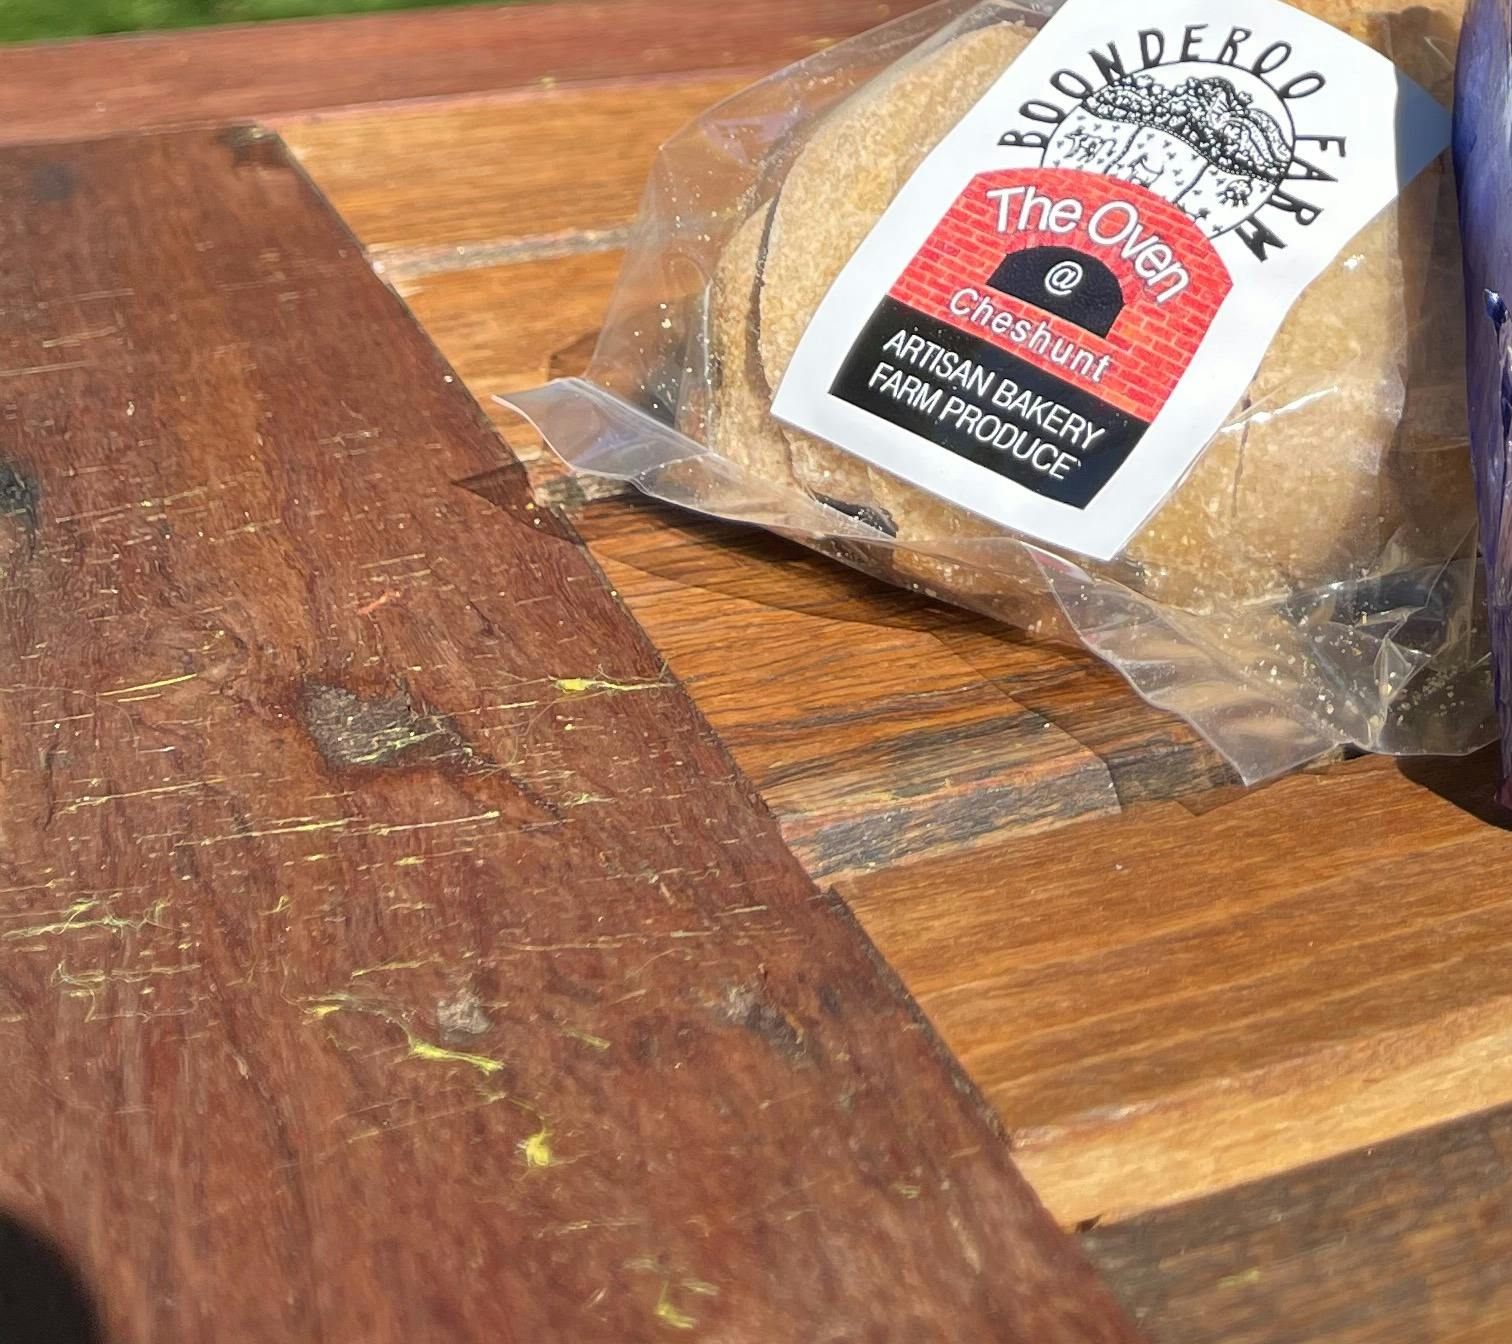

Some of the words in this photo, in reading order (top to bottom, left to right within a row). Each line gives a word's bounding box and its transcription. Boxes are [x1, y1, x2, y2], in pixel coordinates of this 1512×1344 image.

[986, 185, 1083, 234] The
[1088, 201, 1191, 302] Oven
[1234, 135, 1348, 263] FARM
[1045, 259, 1084, 296] @
[868, 361, 944, 414] FARM
[949, 287, 1112, 382] Cheshunt
[882, 329, 997, 396] ARTISAN
[993, 378, 1105, 451] BAKERY
